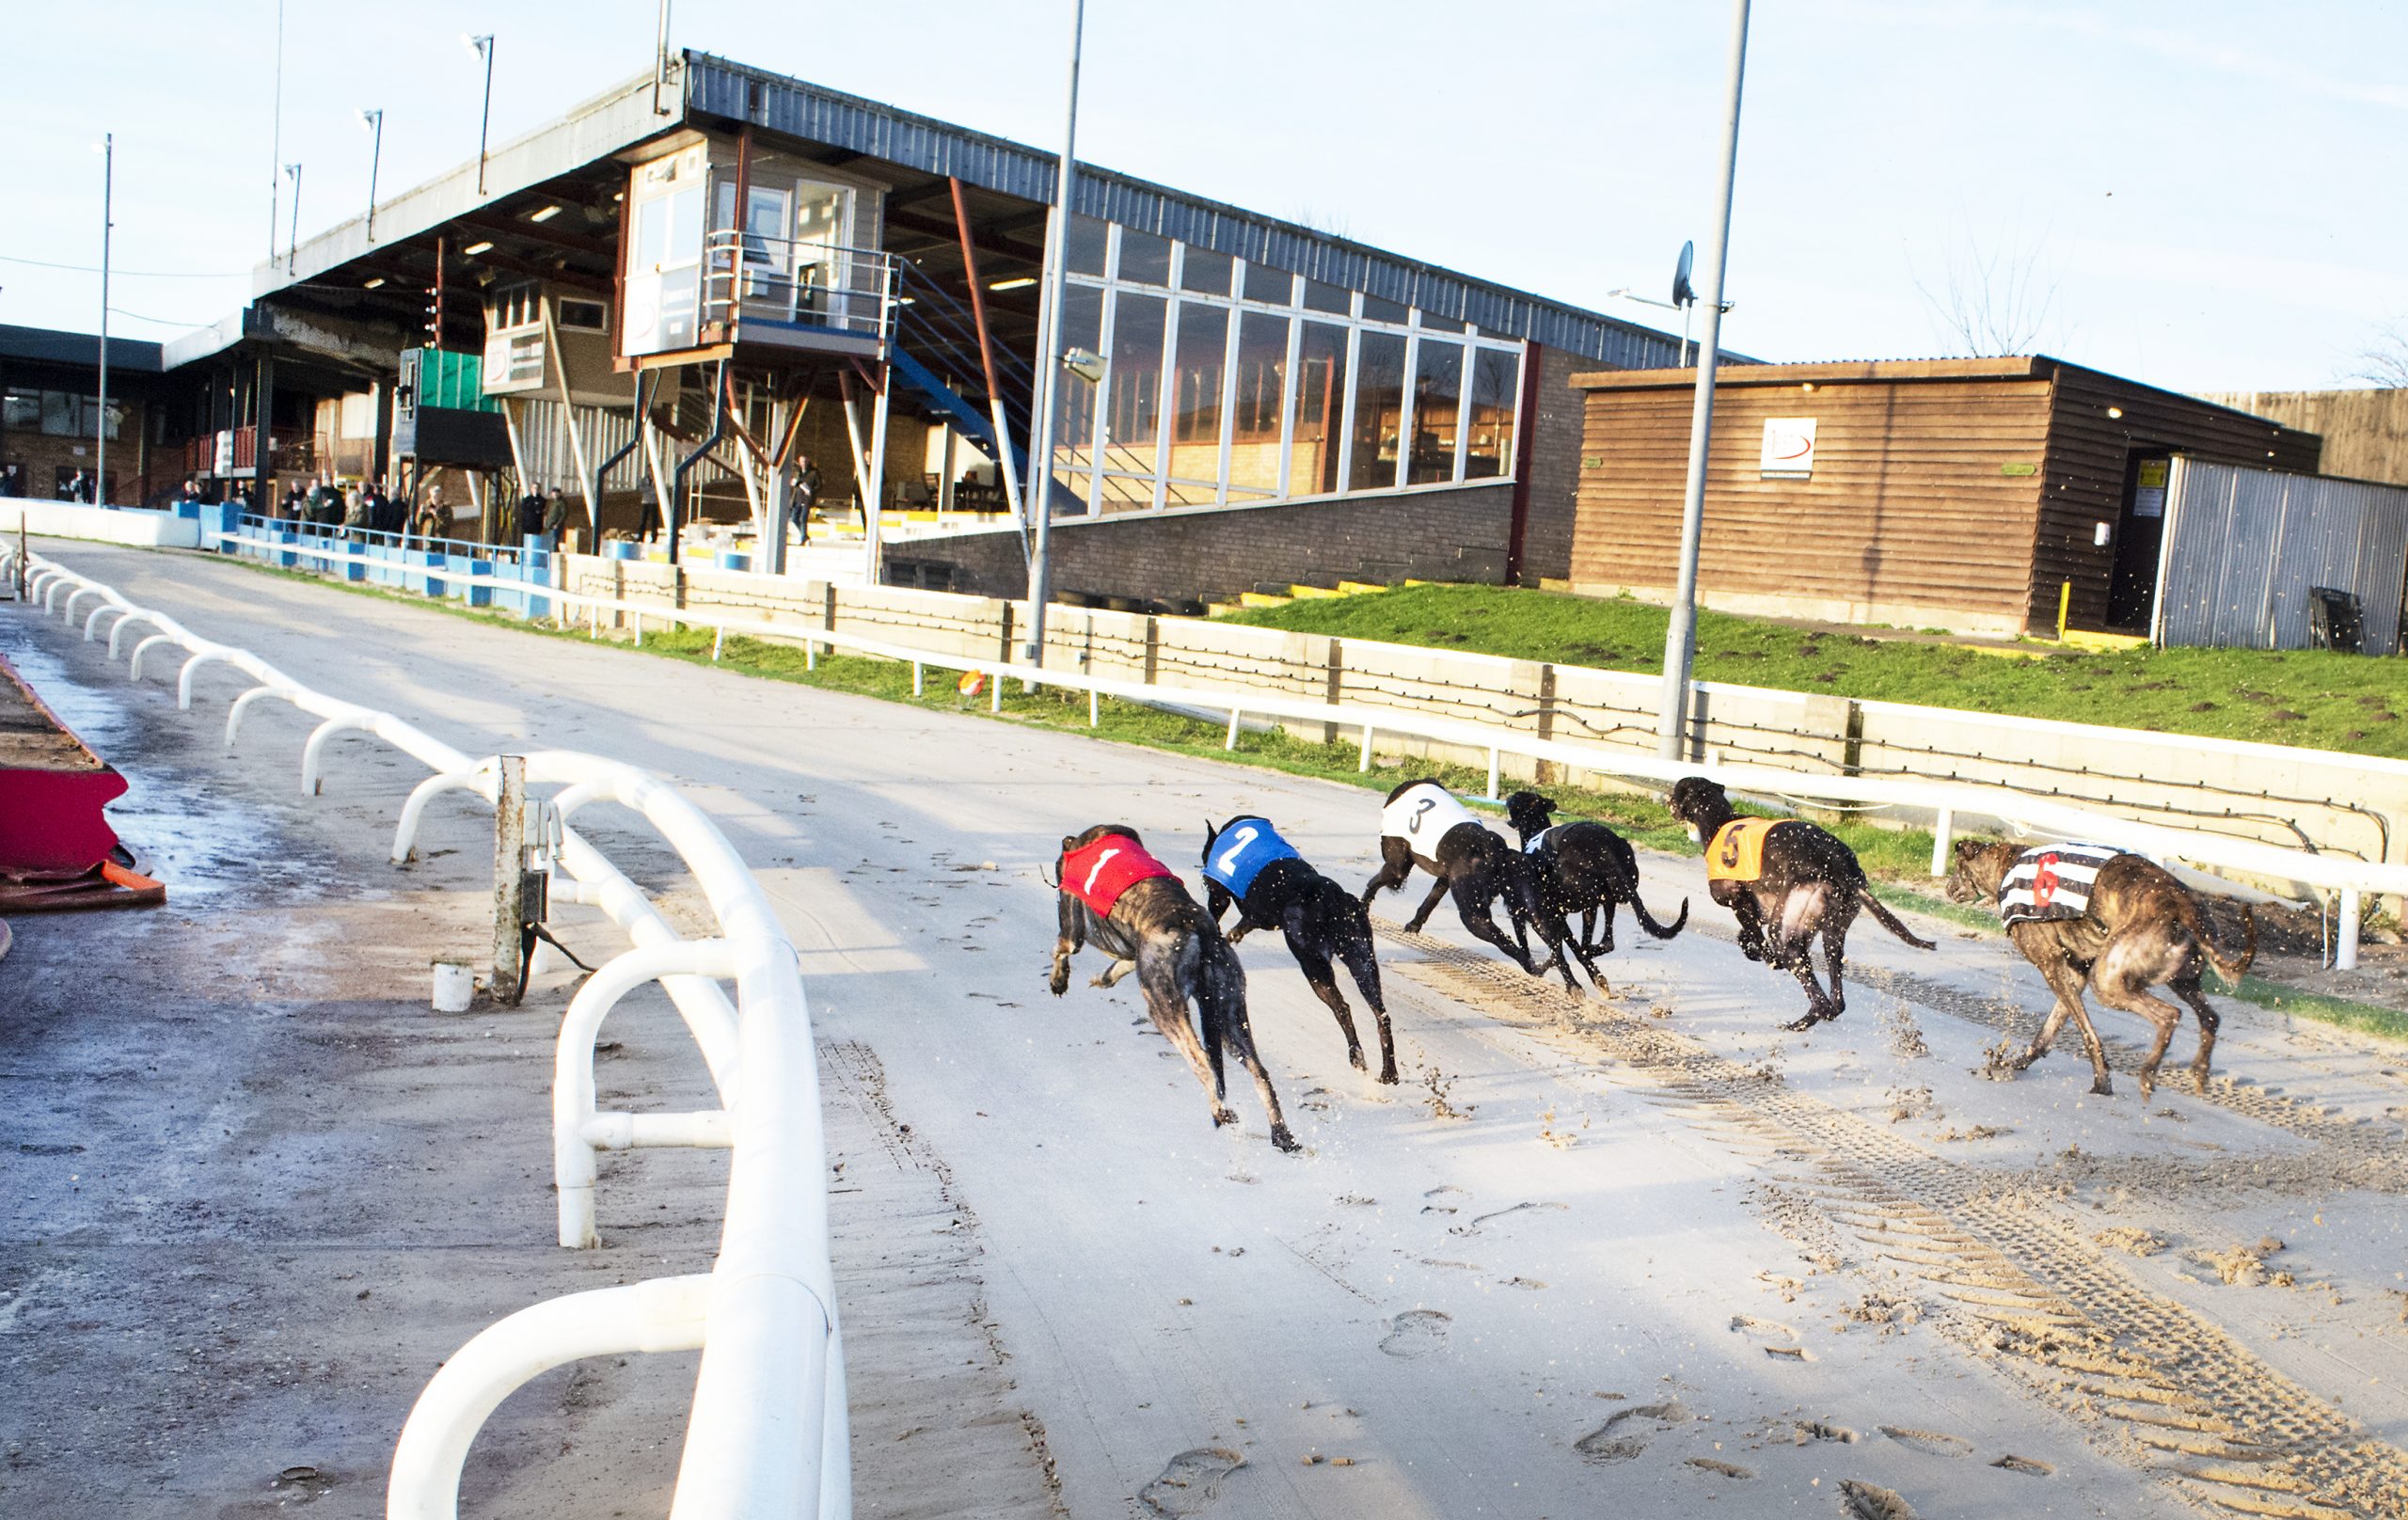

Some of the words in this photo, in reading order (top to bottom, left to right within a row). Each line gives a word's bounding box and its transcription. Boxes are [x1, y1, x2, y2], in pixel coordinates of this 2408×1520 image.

[1409, 798, 1436, 834] 3
[1218, 826, 1259, 877] 2
[1721, 824, 1747, 868] 5
[1084, 848, 1120, 895] 1
[2034, 853, 2060, 907] 6
